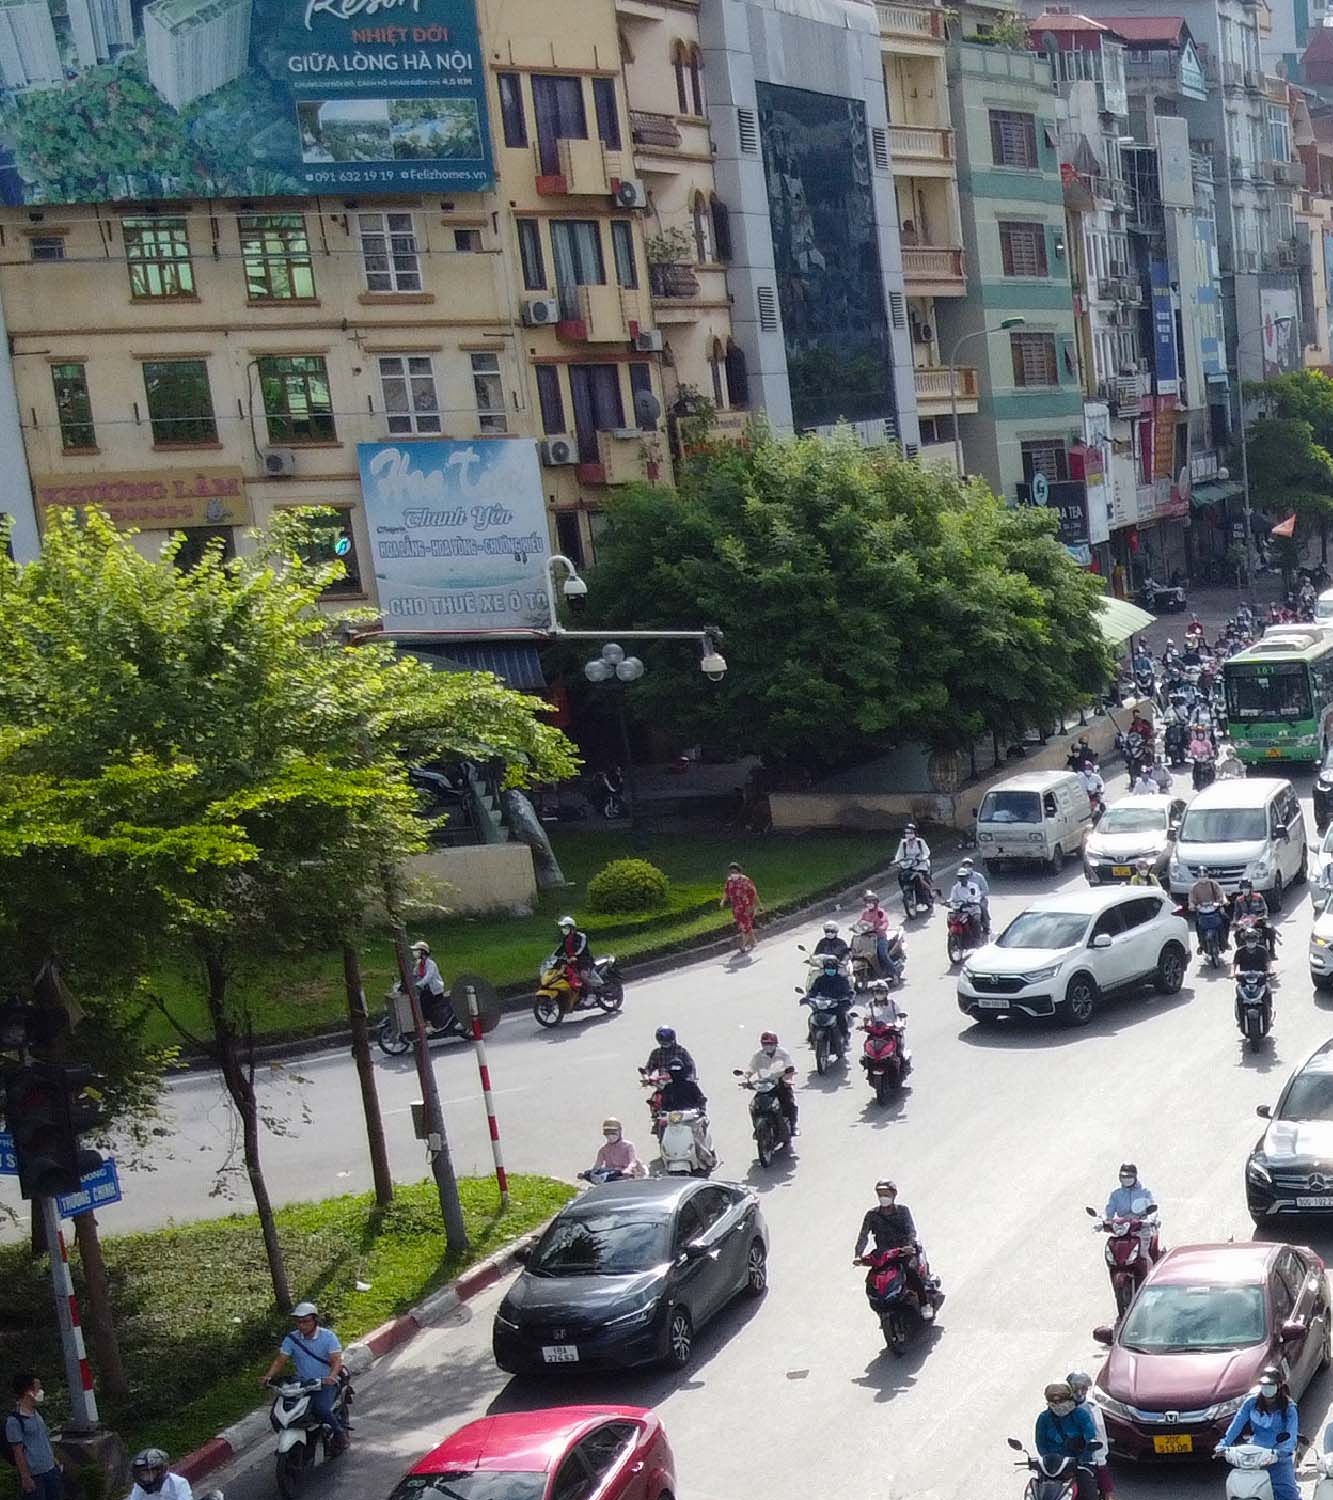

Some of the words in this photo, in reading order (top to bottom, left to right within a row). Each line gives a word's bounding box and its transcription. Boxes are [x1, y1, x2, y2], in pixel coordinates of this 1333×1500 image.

[288, 53, 339, 72] GIỮA
[344, 51, 398, 71] LÒNG
[404, 51, 432, 70] HÀ
[437, 50, 473, 73] NỘI
[389, 596, 427, 616] CHO
[431, 591, 477, 615] THUÊ
[481, 594, 505, 614] XE
[509, 590, 521, 611] Ô
